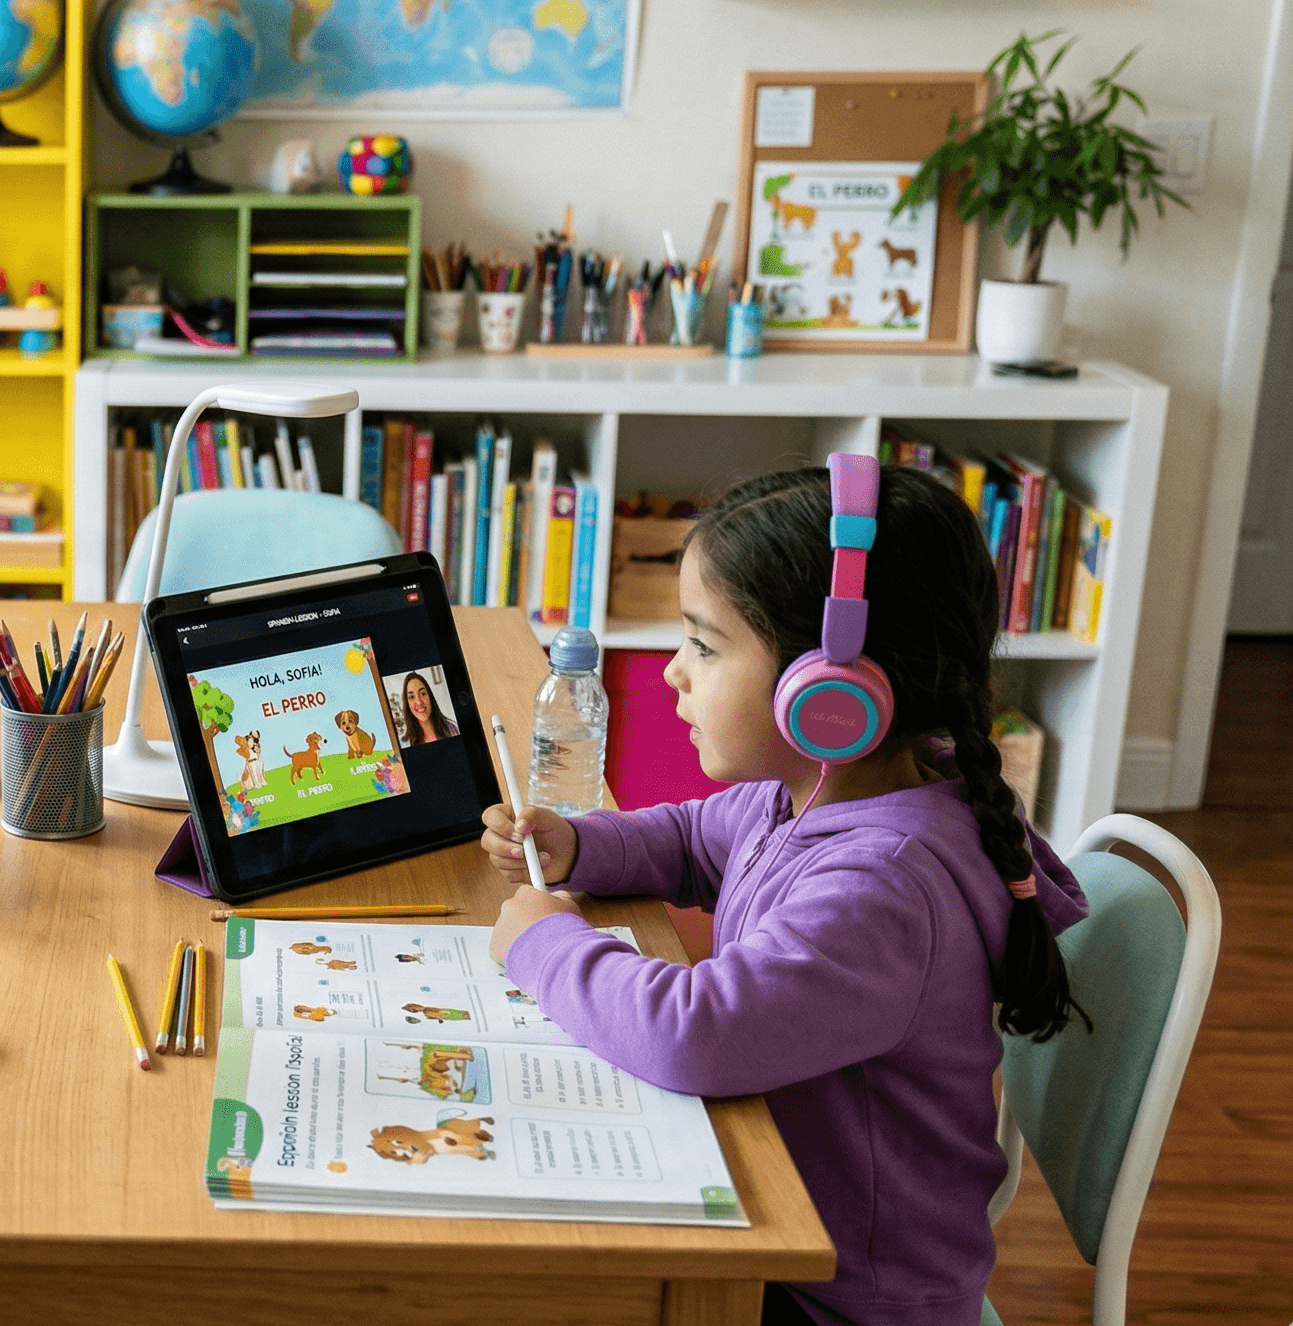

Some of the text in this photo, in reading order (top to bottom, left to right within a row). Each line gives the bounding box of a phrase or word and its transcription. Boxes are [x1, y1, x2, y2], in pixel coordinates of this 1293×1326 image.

[808, 183, 889, 200] EL PERRO
[249, 672, 285, 690] HOLA,
[261, 691, 327, 718] EL PERRO
[282, 1073, 301, 1113] lesson
